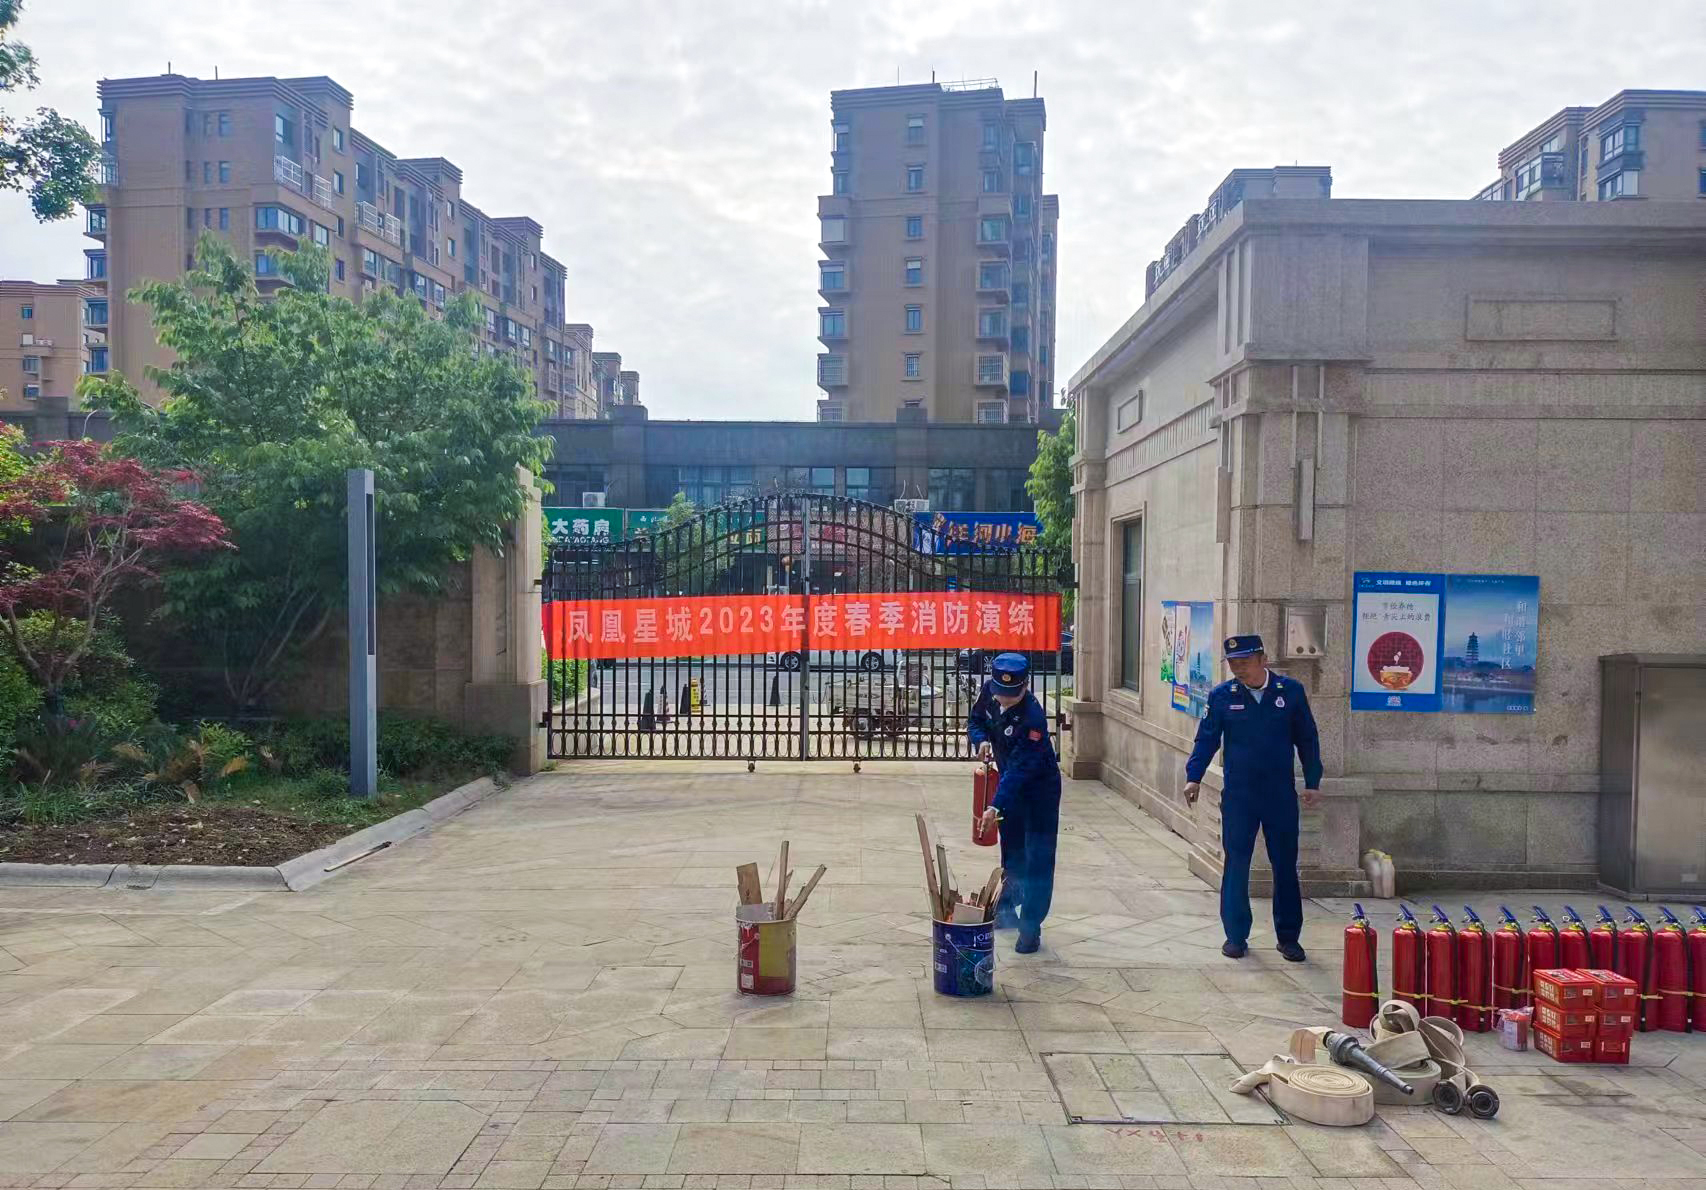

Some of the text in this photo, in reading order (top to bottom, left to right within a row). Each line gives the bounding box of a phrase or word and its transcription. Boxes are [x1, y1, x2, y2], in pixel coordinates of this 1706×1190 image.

[552, 518, 610, 536] 大药房
[567, 600, 1036, 644] 凤凰星城2023年度春季消防演练
